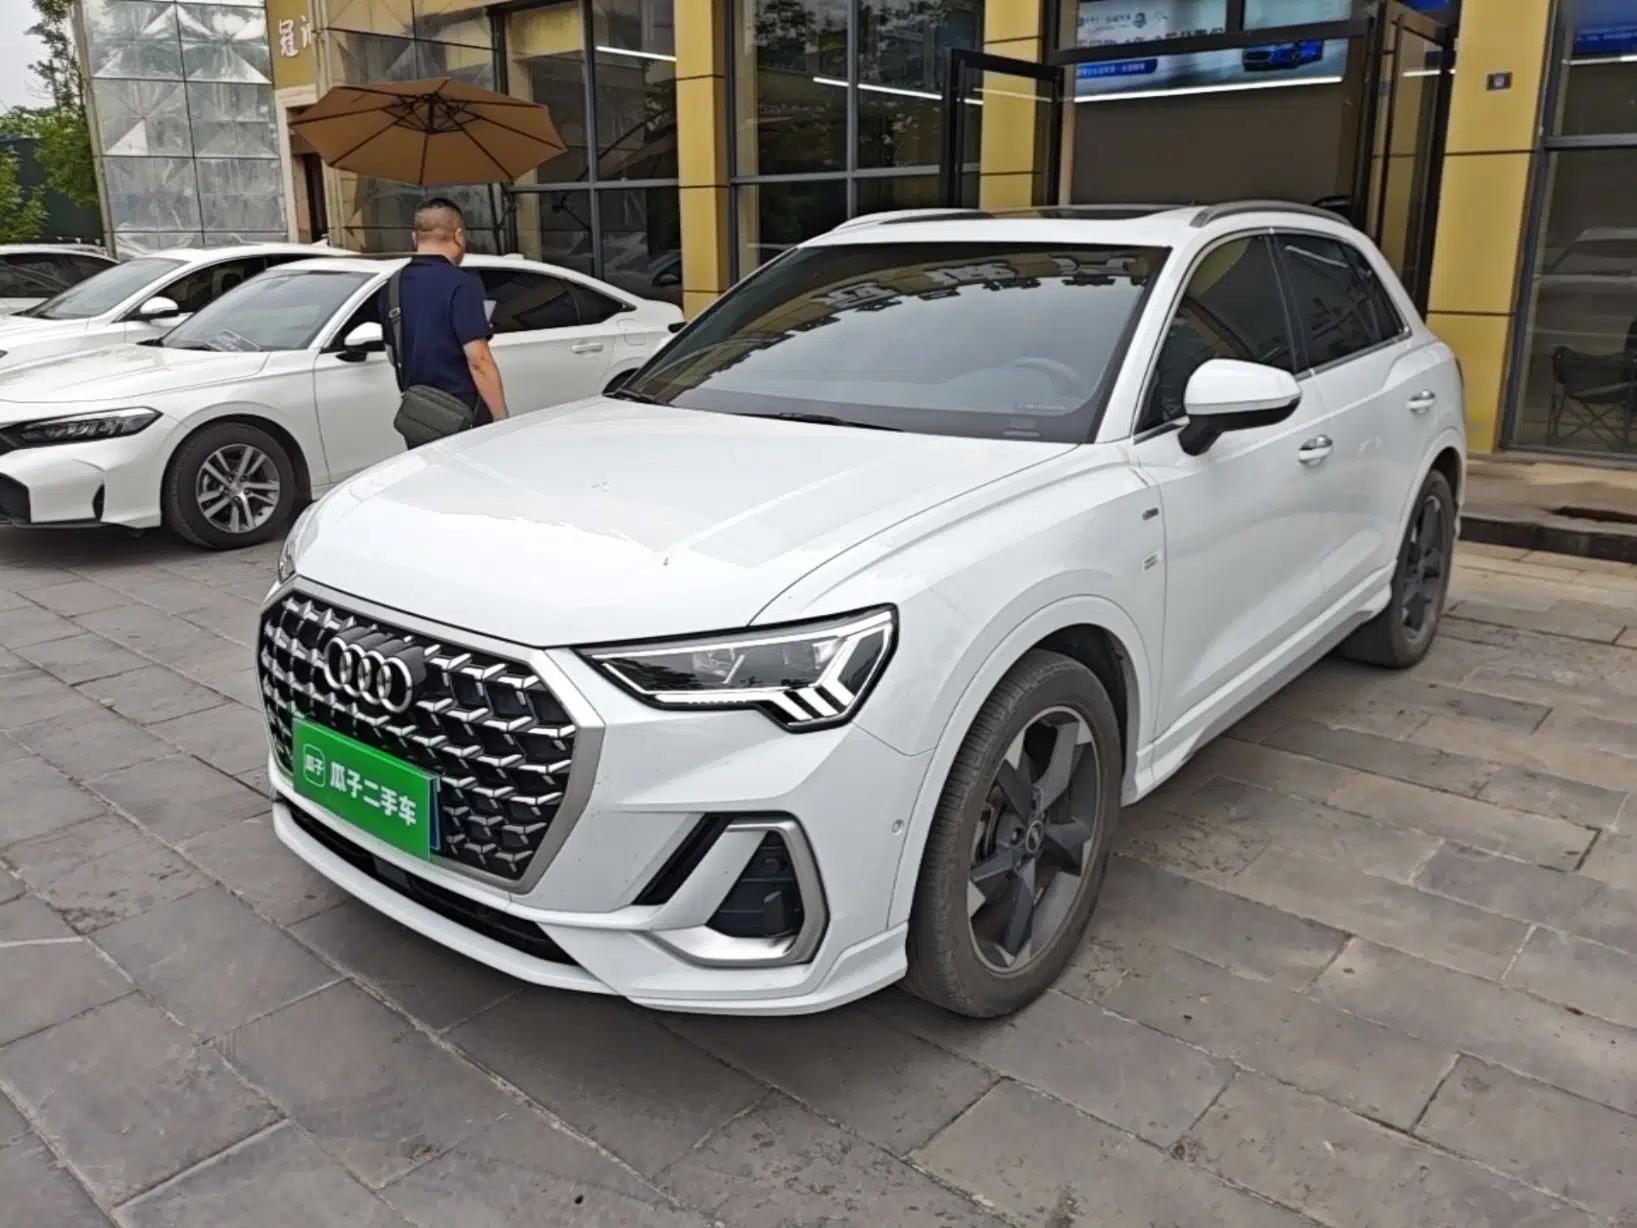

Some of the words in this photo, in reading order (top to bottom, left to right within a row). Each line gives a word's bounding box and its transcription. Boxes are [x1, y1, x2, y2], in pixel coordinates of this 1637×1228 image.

[330, 761, 417, 826] 瓜子二手车
